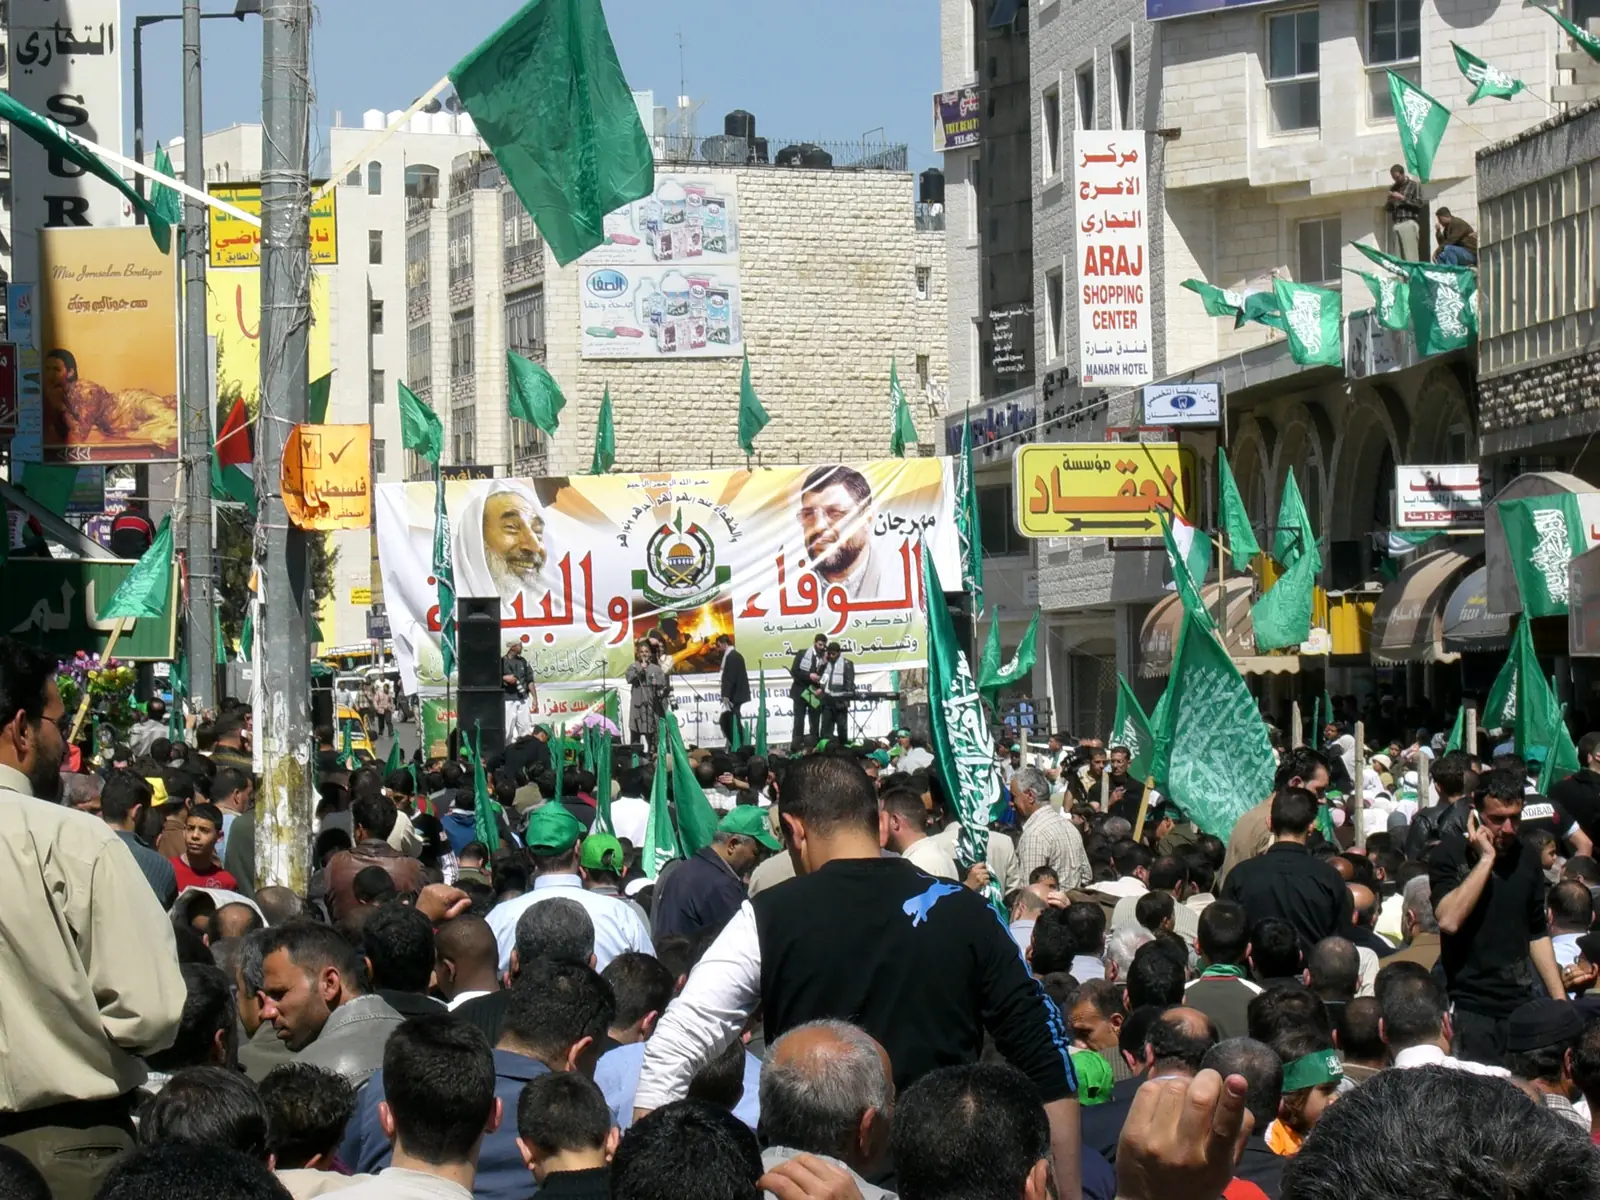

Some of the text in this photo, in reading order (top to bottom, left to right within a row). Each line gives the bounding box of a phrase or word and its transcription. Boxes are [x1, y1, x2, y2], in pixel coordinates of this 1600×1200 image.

[16, 19, 114, 74] التجاري
[1080, 143, 1138, 168] مركز
[1080, 176, 1140, 200] الاعرج
[1081, 209, 1142, 237] التجاري
[1084, 245, 1143, 276] ARAJ
[52, 263, 162, 282] Miss Jerusalem Boutique
[592, 277, 623, 292] الصفا
[1083, 284, 1144, 305] SHOPPING
[1092, 309, 1138, 330] CENTER
[1085, 340, 1147, 356] فندق منارة
[1086, 363, 1148, 376] MANARH HOTEL
[1063, 454, 1111, 473] مؤسسة
[1030, 459, 1191, 514] العقاد
[874, 513, 936, 536] مهرجان
[1424, 512, 1435, 520] 12
[763, 618, 822, 635] السنوية
[852, 612, 912, 629] الذكرى
[857, 637, 918, 656] وتستمر
[1522, 804, 1552, 818] NDIBAD
